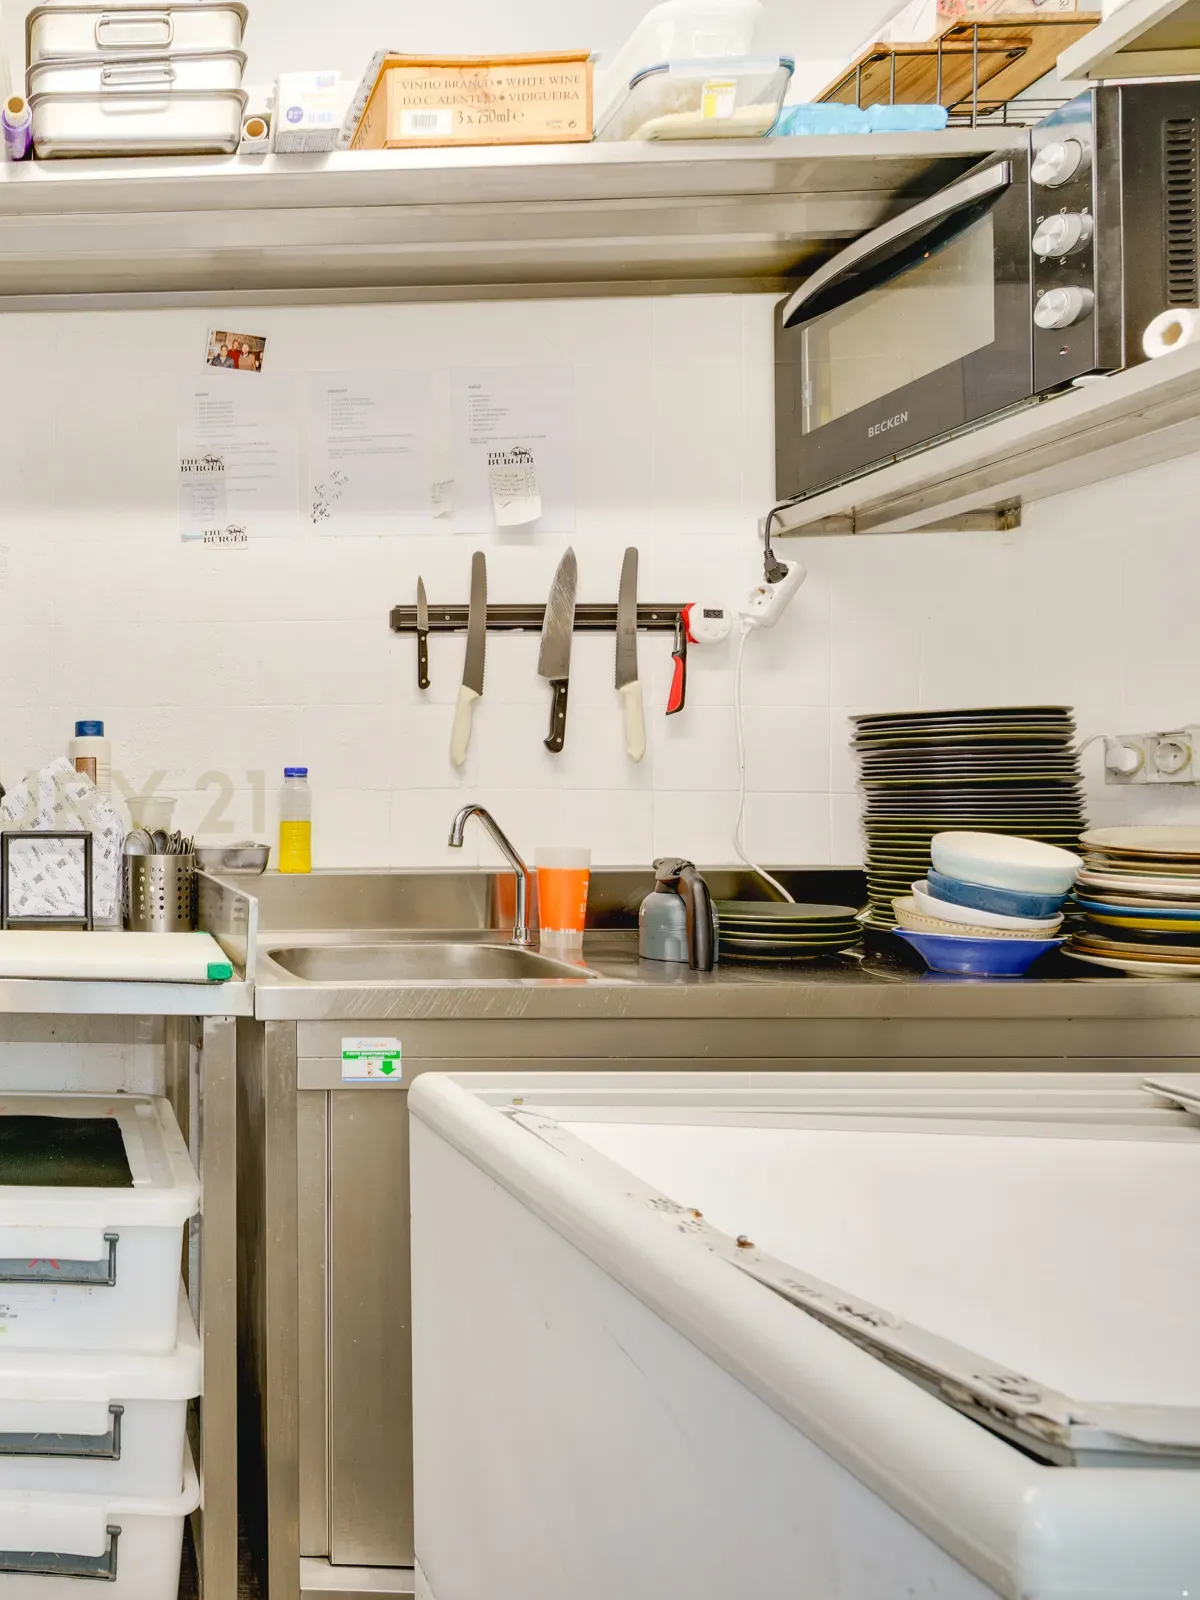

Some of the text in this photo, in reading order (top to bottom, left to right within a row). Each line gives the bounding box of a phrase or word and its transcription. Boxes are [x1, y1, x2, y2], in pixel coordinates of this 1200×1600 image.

[402, 75, 581, 90] VINHO BRANCO WHITE WINE
[508, 91, 580, 102] VIDIGUEIRA
[457, 111, 464, 125] 3
[476, 108, 511, 124] 750ml
[868, 411, 908, 438] BECKEN
[487, 457, 534, 466] BURGER
[203, 535, 248, 543] BURGER
